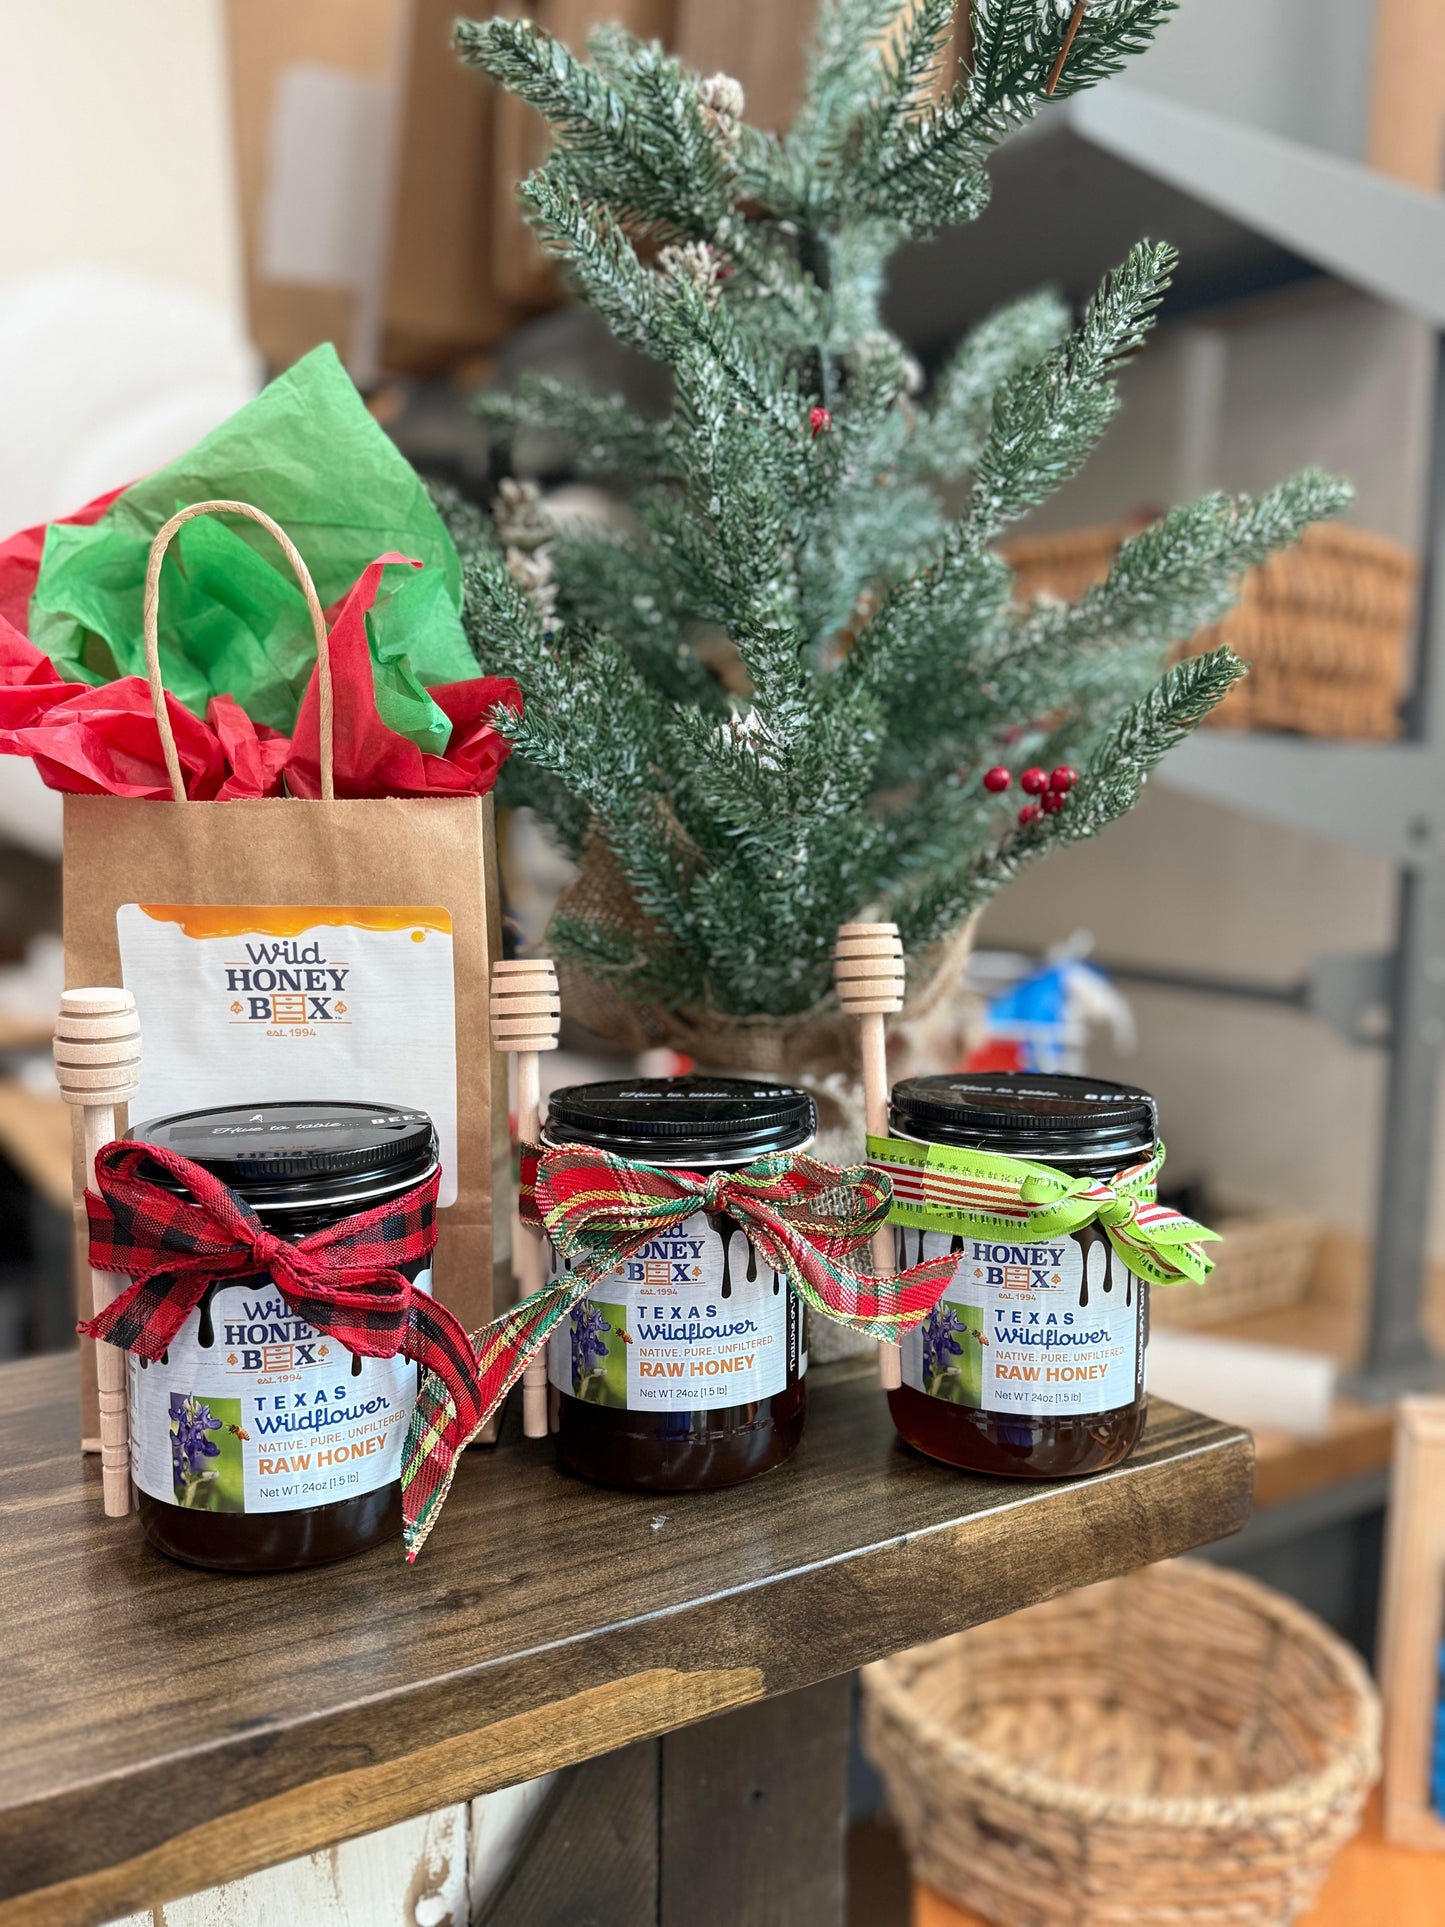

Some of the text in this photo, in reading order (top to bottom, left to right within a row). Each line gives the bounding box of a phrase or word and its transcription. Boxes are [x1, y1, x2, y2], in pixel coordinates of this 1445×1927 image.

[246, 941, 327, 965] Wild
[225, 969, 350, 991] HONEY
[289, 1028, 316, 1037] 1994
[633, 1241, 705, 1259] ONEY
[972, 1242, 1065, 1266] HONEY
[657, 1288, 678, 1296] 1994
[1015, 1293, 1036, 1301] 1994
[243, 1298, 296, 1321] Wil
[637, 1305, 717, 1319] TEXAS
[995, 1309, 1075, 1325] TEXAS
[224, 1320, 329, 1345] HONE
[637, 1318, 758, 1344] Wildflower
[995, 1326, 1112, 1350] Wildflower
[639, 1335, 775, 1357] NATIVE. PURE. UNFILTERED.
[996, 1350, 1038, 1361] NATIVE.
[1040, 1352, 1071, 1362] PURE.
[639, 1354, 755, 1378] RAW HONEY
[995, 1363, 1108, 1382] RAW HONEY
[277, 1374, 302, 1383] 1994
[254, 1386, 347, 1411] TEXAS
[640, 1388, 657, 1398] Net
[658, 1388, 674, 1398] WT
[676, 1388, 698, 1398] 24oz
[995, 1390, 1011, 1400] Net
[1013, 1391, 1030, 1401] WT
[1031, 1392, 1054, 1402] 24oz
[254, 1396, 390, 1435] Wildflower
[258, 1409, 407, 1453] NATIVE. PURE. UNFILTERED.
[258, 1434, 388, 1475] RAW HONEY
[260, 1487, 280, 1499] Net
[281, 1484, 300, 1496] WT
[302, 1480, 327, 1493] 24oz
